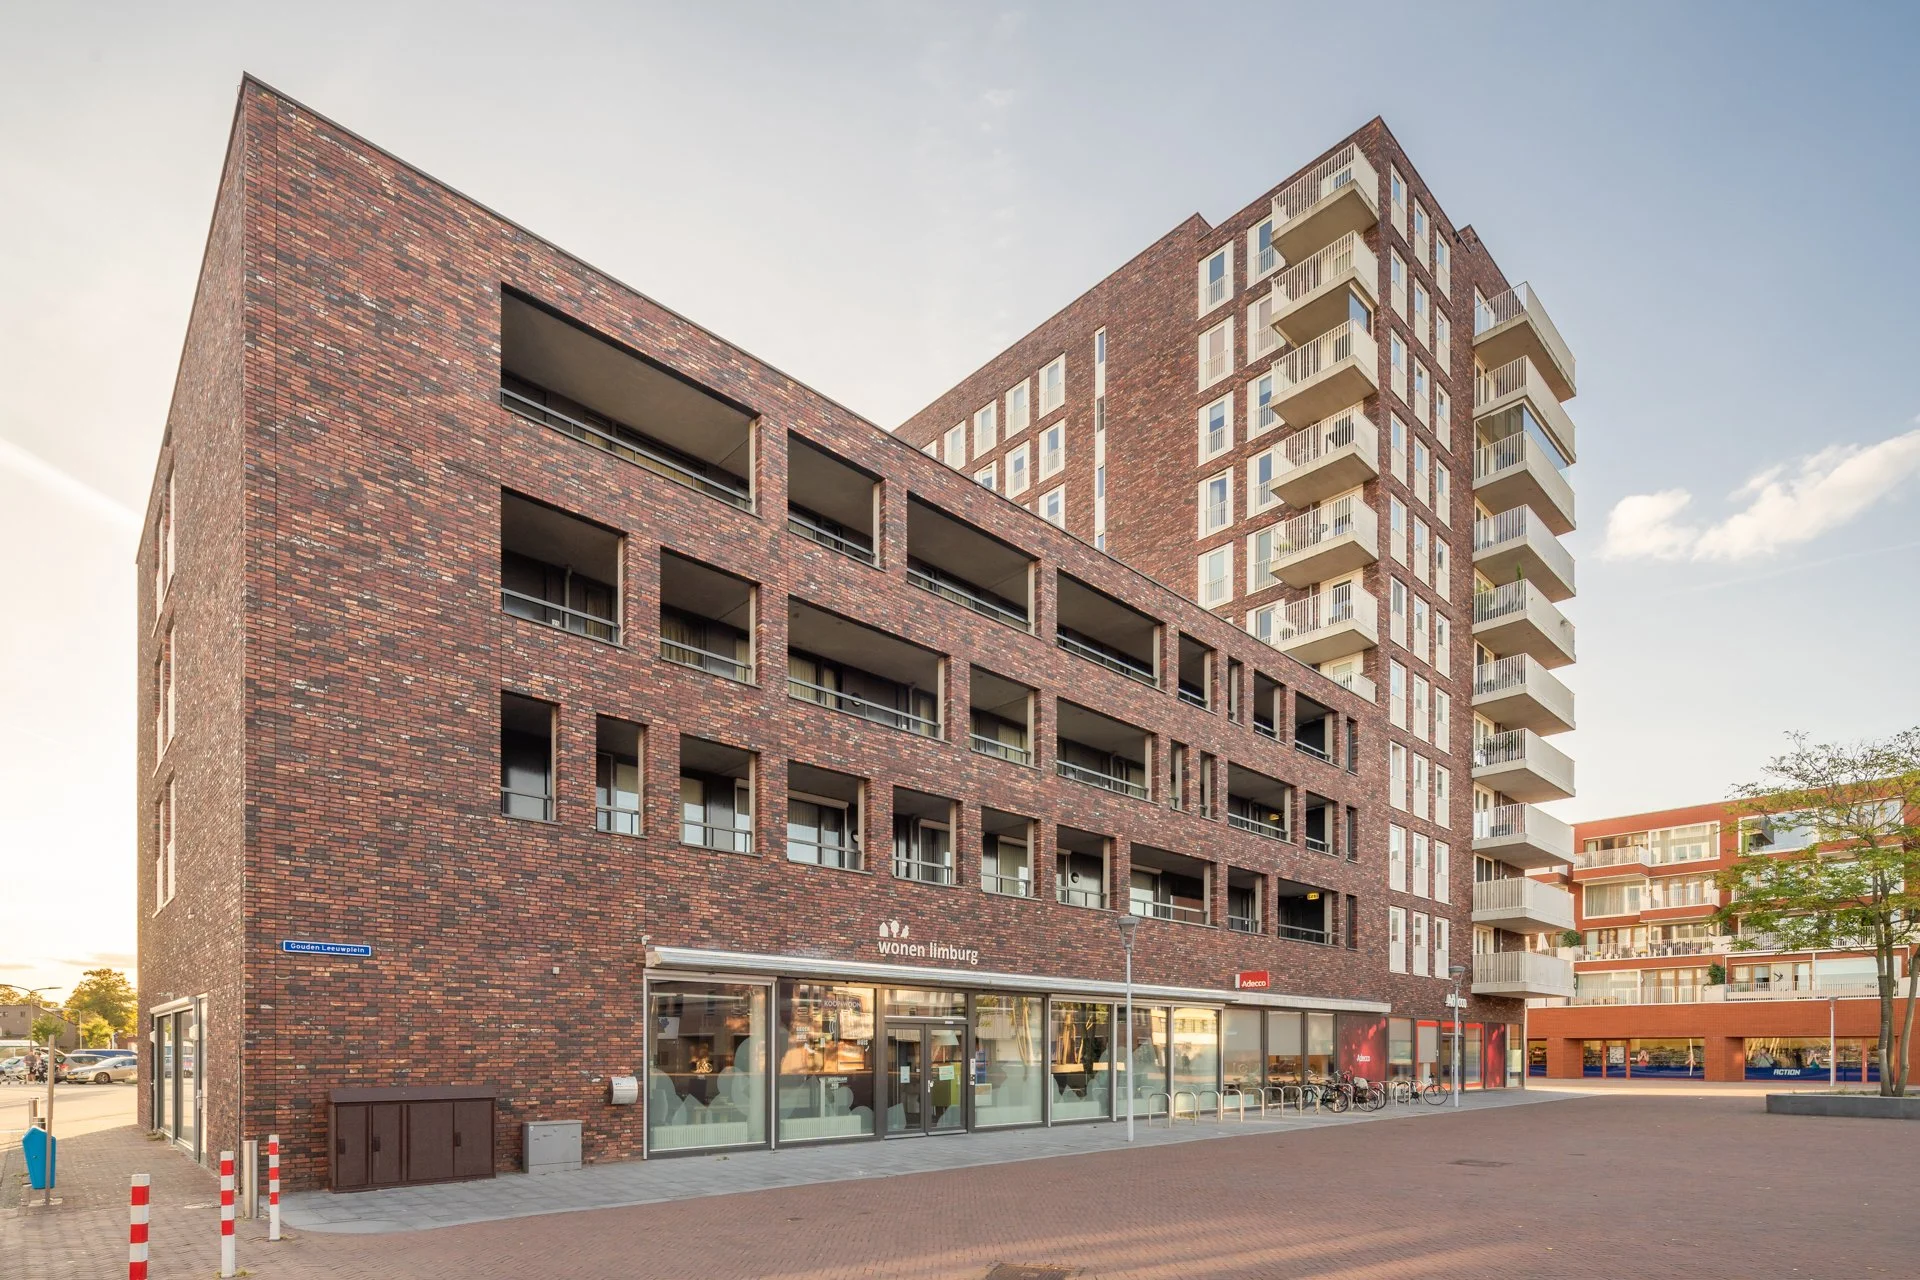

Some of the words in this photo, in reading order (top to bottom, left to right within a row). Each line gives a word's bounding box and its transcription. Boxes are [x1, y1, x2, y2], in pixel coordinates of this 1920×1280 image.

[290, 942, 320, 951] Gouden
[321, 945, 365, 954] Leeuwplein
[878, 941, 925, 957] wonen
[929, 942, 979, 965] limburg
[1241, 980, 1267, 988] Adecco
[1445, 993, 1468, 1008] Adcco
